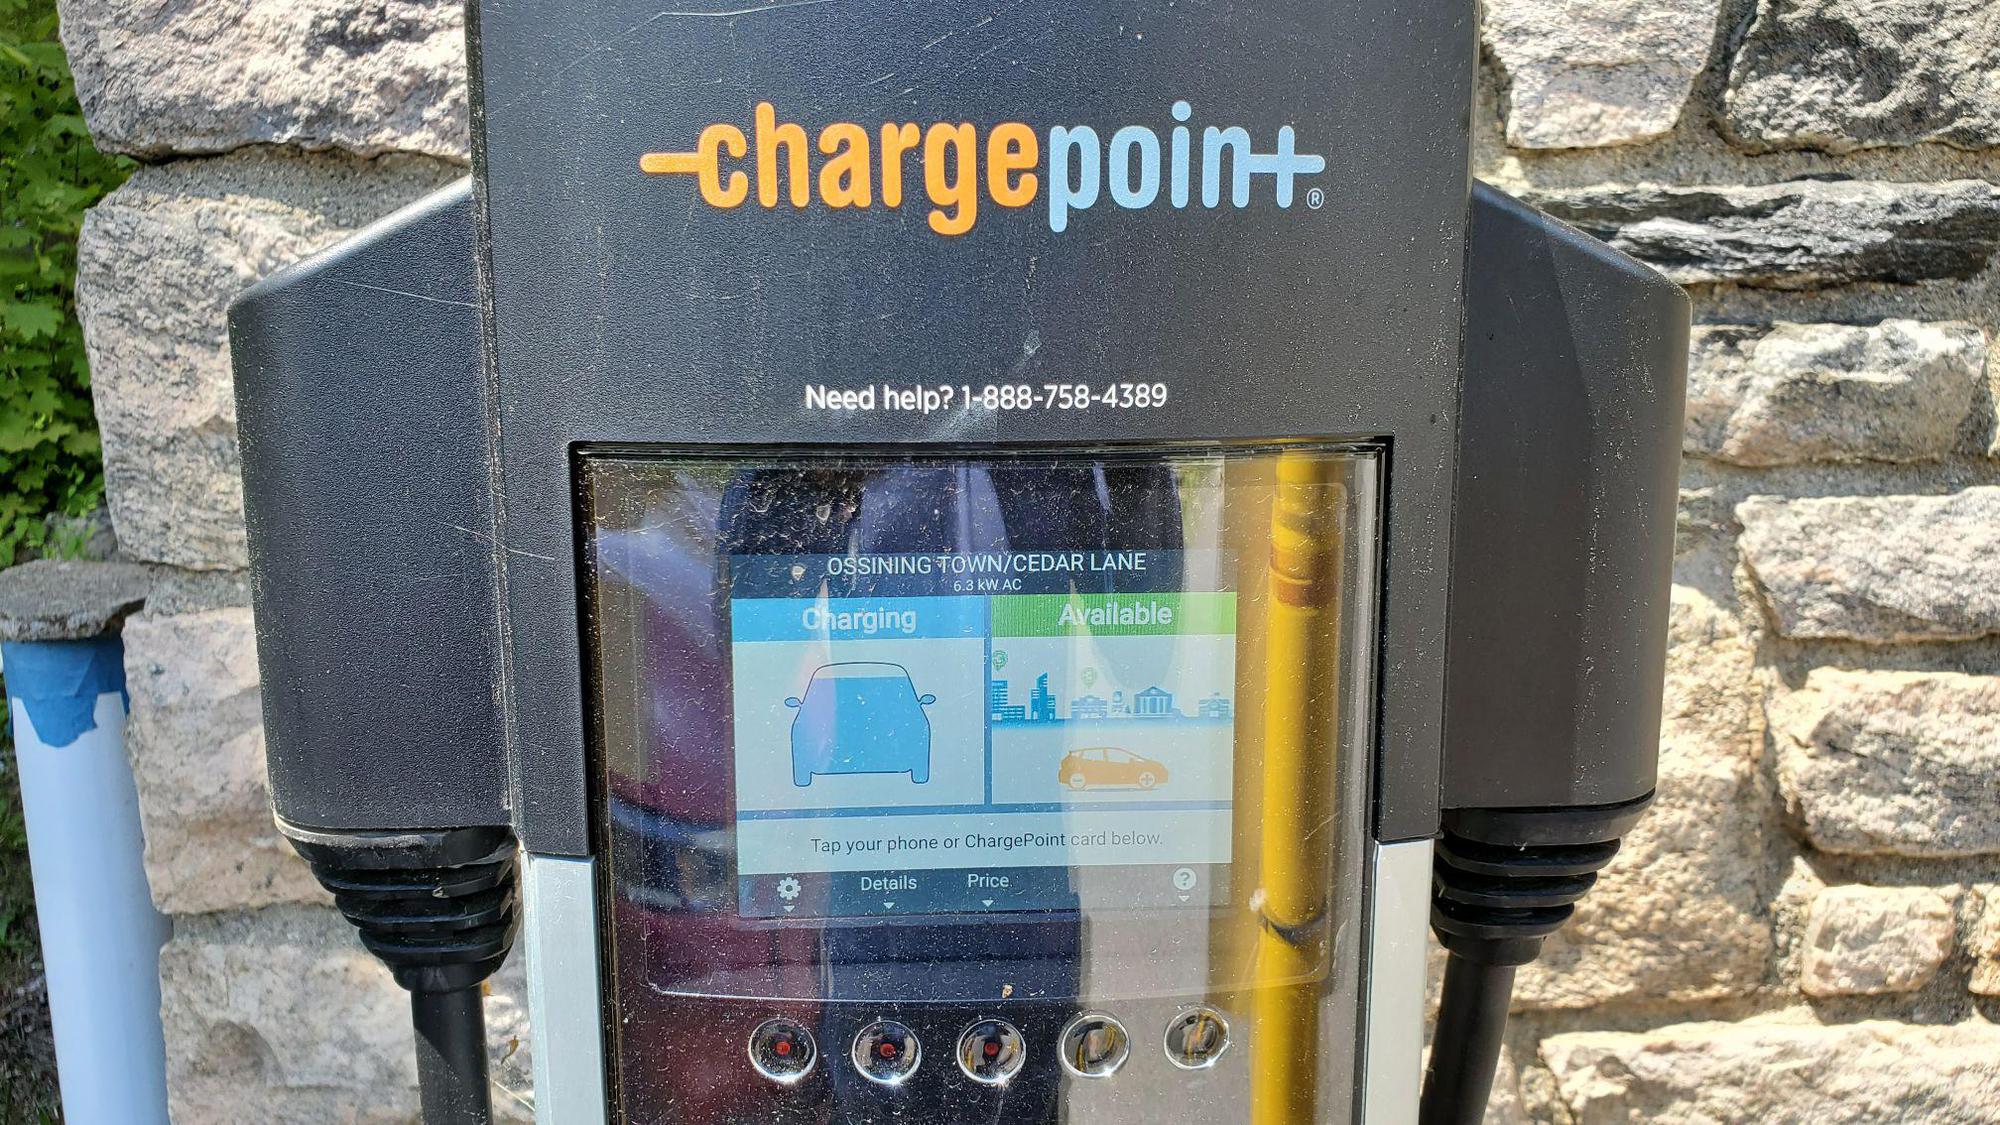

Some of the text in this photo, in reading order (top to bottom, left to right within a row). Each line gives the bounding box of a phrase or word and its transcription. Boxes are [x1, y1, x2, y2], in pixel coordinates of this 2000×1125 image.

[805, 383, 1168, 415] Need help? 1-888-758-4389
[827, 553, 1147, 576] OSSINING TOWN/CEDAR LANE
[953, 578, 1022, 592] 6.3 kW AC
[802, 606, 917, 635] Charging
[1058, 601, 1172, 627] Available
[811, 830, 1164, 857] Tap your phone or ChargePoint card below.
[860, 874, 918, 892] Details
[967, 873, 1009, 890] Price
